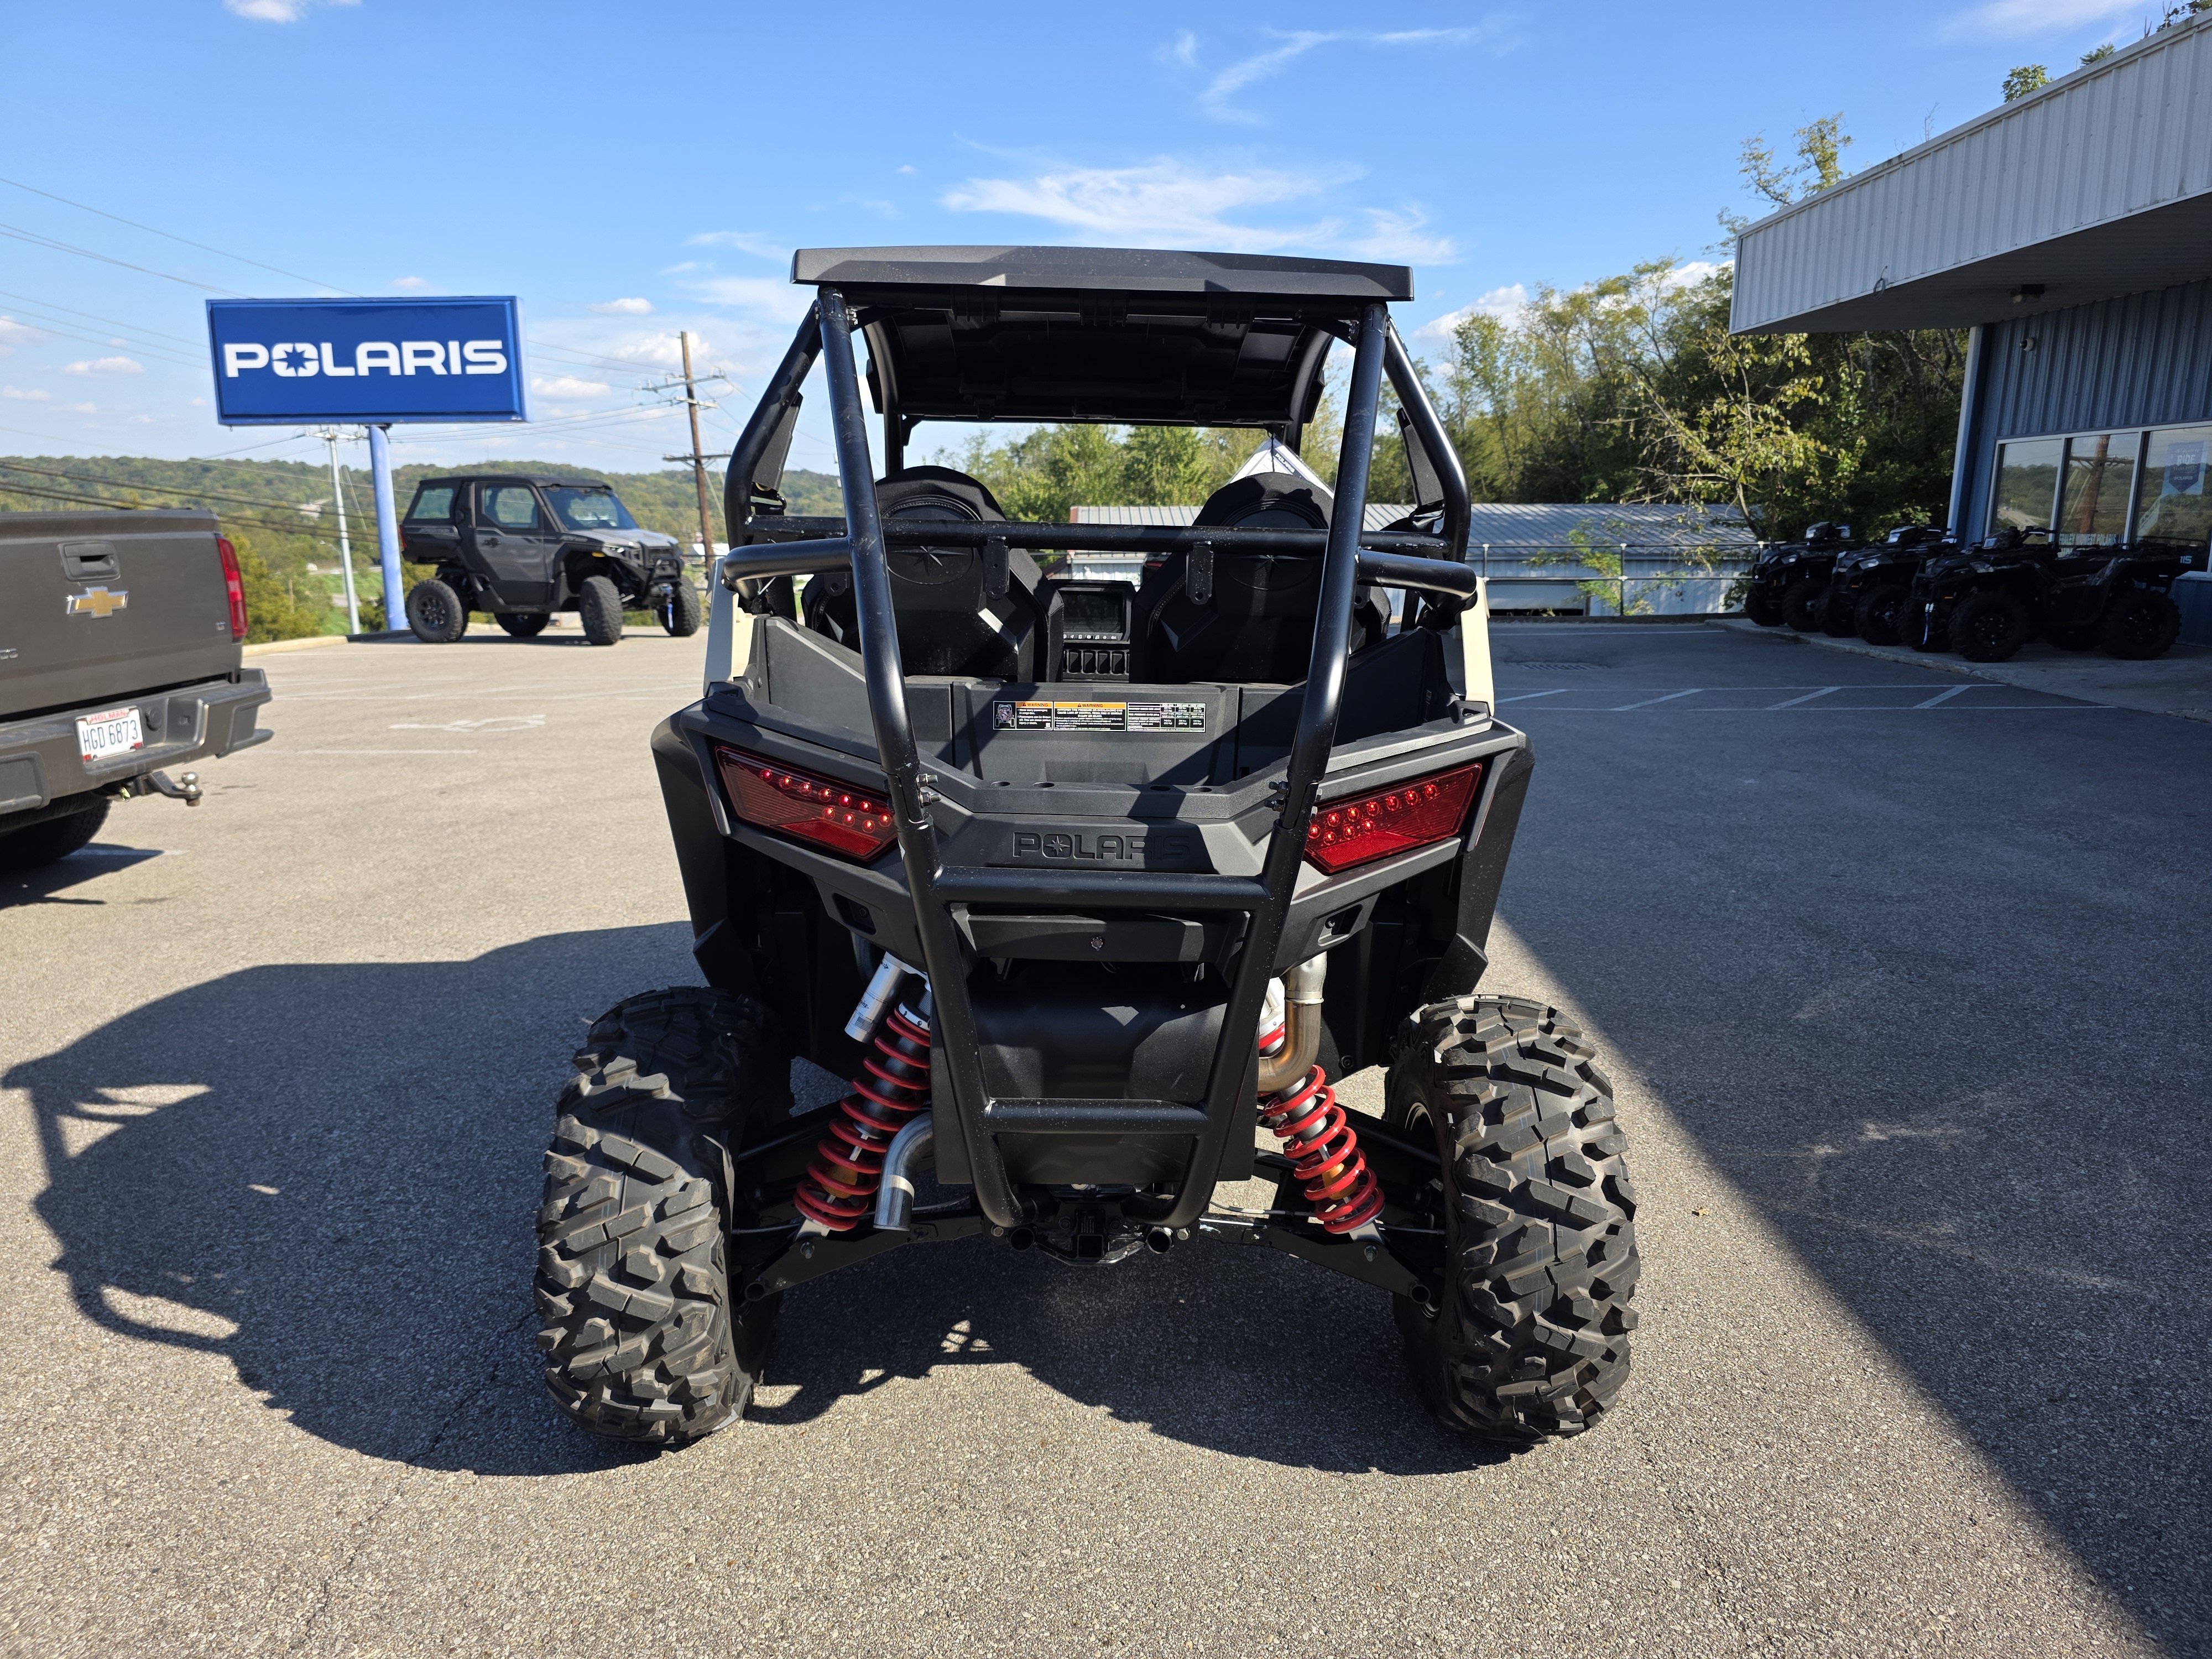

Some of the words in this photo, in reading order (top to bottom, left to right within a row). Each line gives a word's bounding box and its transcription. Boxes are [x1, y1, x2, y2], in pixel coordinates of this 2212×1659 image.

[224, 340, 507, 378] POLARIS
[2177, 454, 2195, 465] RIDE
[91, 711, 126, 723] HOLMAN
[82, 727, 106, 752] HGD
[108, 719, 138, 745] 6873
[1013, 832, 1190, 861] POLARIS
